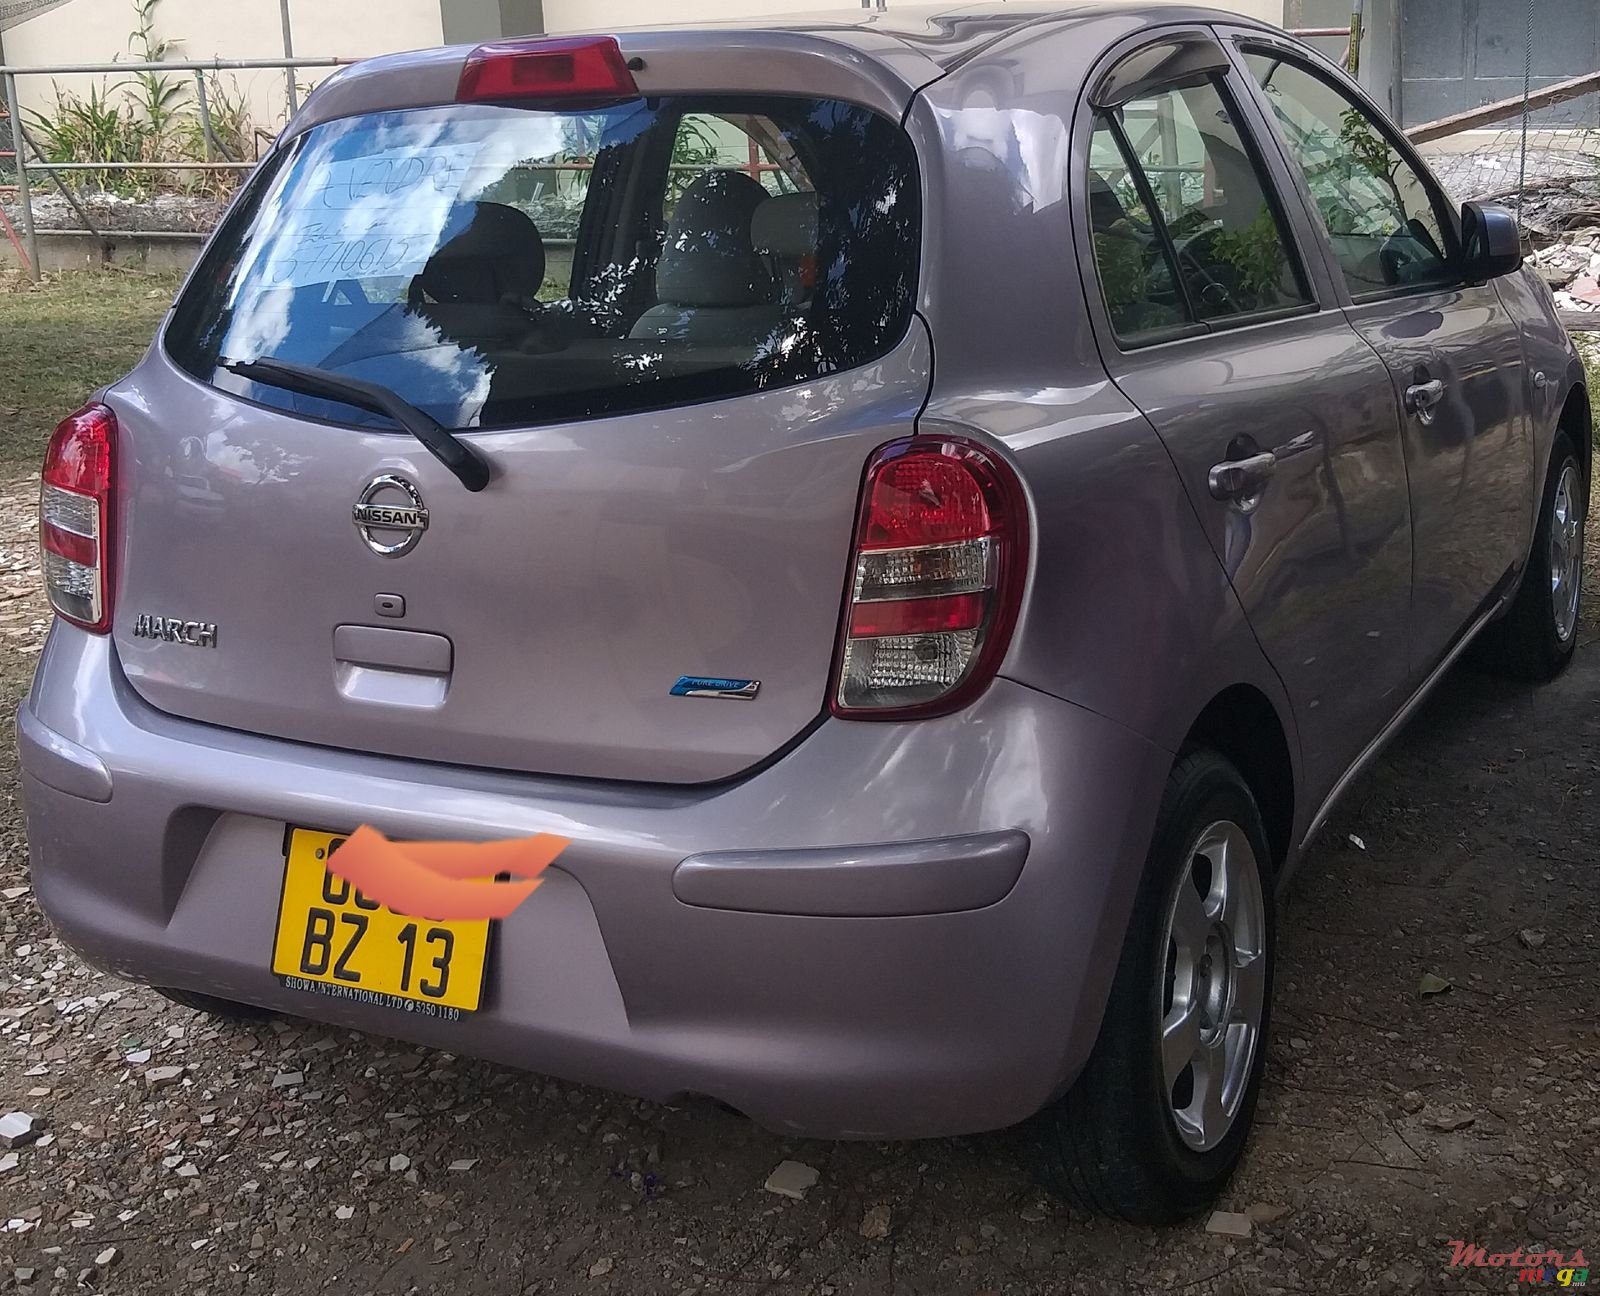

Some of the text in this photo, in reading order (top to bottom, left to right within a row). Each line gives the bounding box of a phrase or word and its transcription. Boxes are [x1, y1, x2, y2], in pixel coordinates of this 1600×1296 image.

[354, 507, 417, 525] NISSAN
[133, 612, 218, 649] MARCH
[715, 680, 740, 688] DRIVE
[299, 906, 455, 999] BZ 13
[285, 976, 316, 992] SHOWA
[316, 982, 384, 1006] INTERNATIONAL
[386, 995, 404, 1010] LTD
[415, 1002, 436, 1017] 5250
